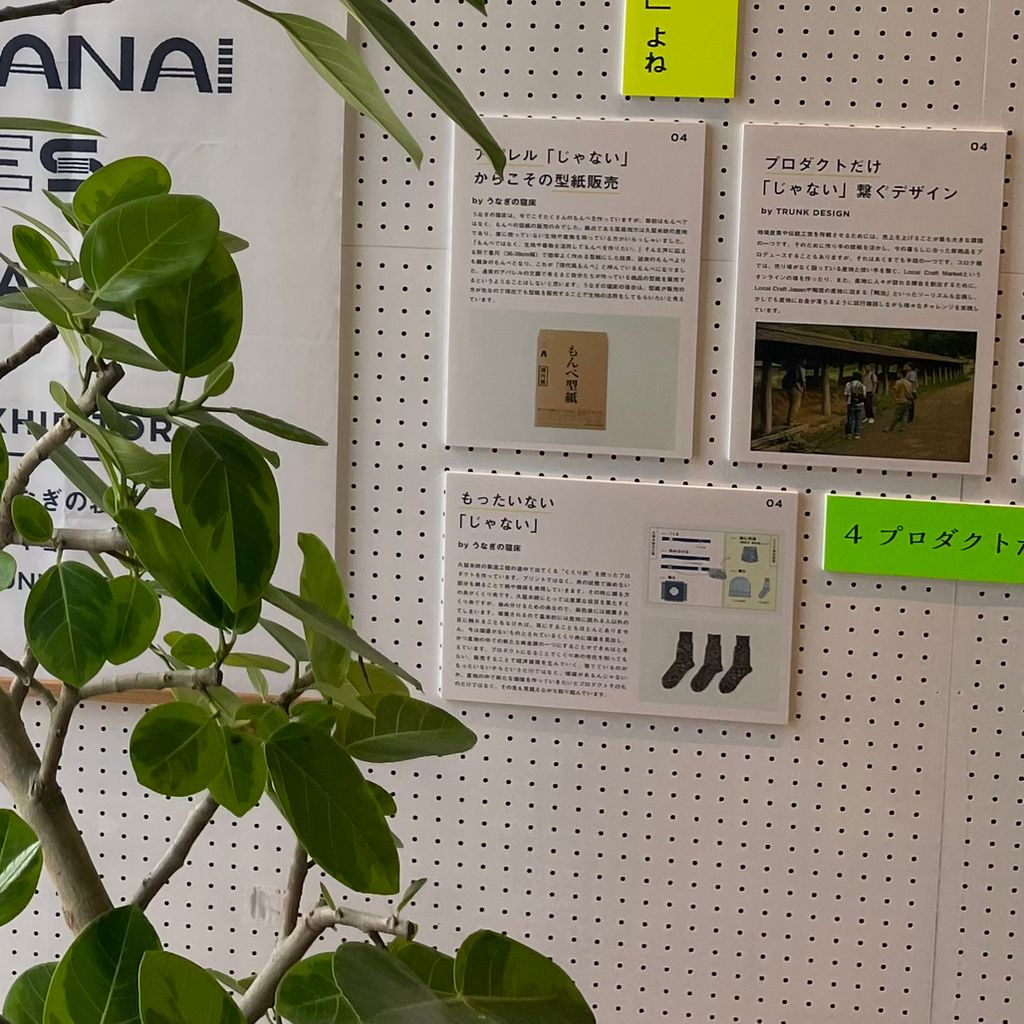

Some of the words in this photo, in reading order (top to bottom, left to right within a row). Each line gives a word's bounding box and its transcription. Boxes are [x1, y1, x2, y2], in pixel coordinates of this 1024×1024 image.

[671, 133, 687, 142] 04
[971, 142, 988, 151] 04
[475, 146, 627, 169] アレル「じゃない」
[765, 156, 881, 176] プロダクトだけ
[474, 170, 619, 192] からこその型紙販売
[763, 180, 957, 200] 「じゃない」繋ぐデザイン
[472, 197, 483, 205] by
[761, 207, 772, 215] by
[776, 208, 809, 216] TRUNK
[813, 209, 850, 217] DESIGN
[461, 492, 554, 511] もったいない
[766, 499, 782, 509] 04
[460, 512, 537, 533] 「じゃない」
[844, 524, 862, 544] 4
[458, 541, 469, 549] by
